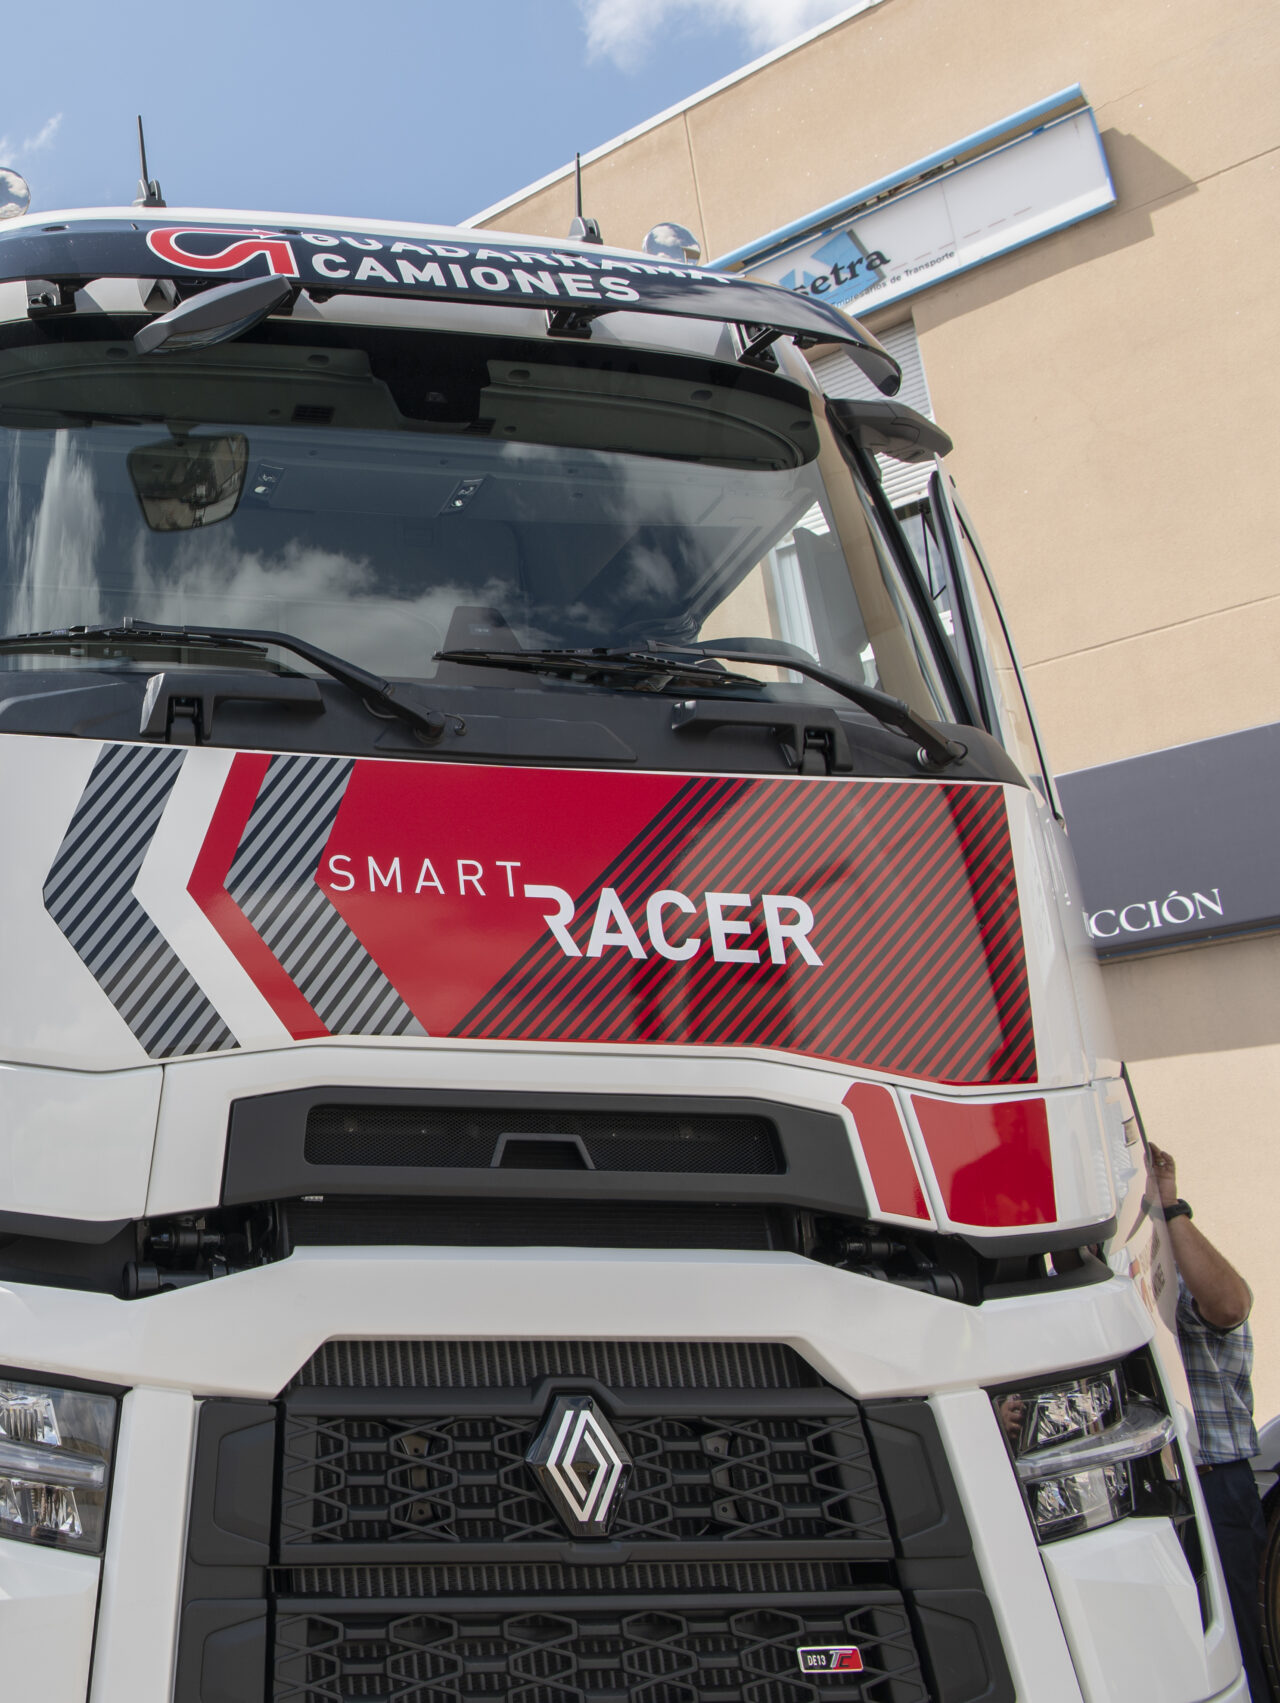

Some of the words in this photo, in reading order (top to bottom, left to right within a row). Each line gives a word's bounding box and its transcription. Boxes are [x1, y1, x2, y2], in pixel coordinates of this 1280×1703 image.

[311, 253, 640, 302] CAMIONES
[904, 250, 955, 277] Transporte
[328, 854, 521, 897] SMART
[524, 884, 824, 966] RACER
[807, 1655, 827, 1666] DE13
